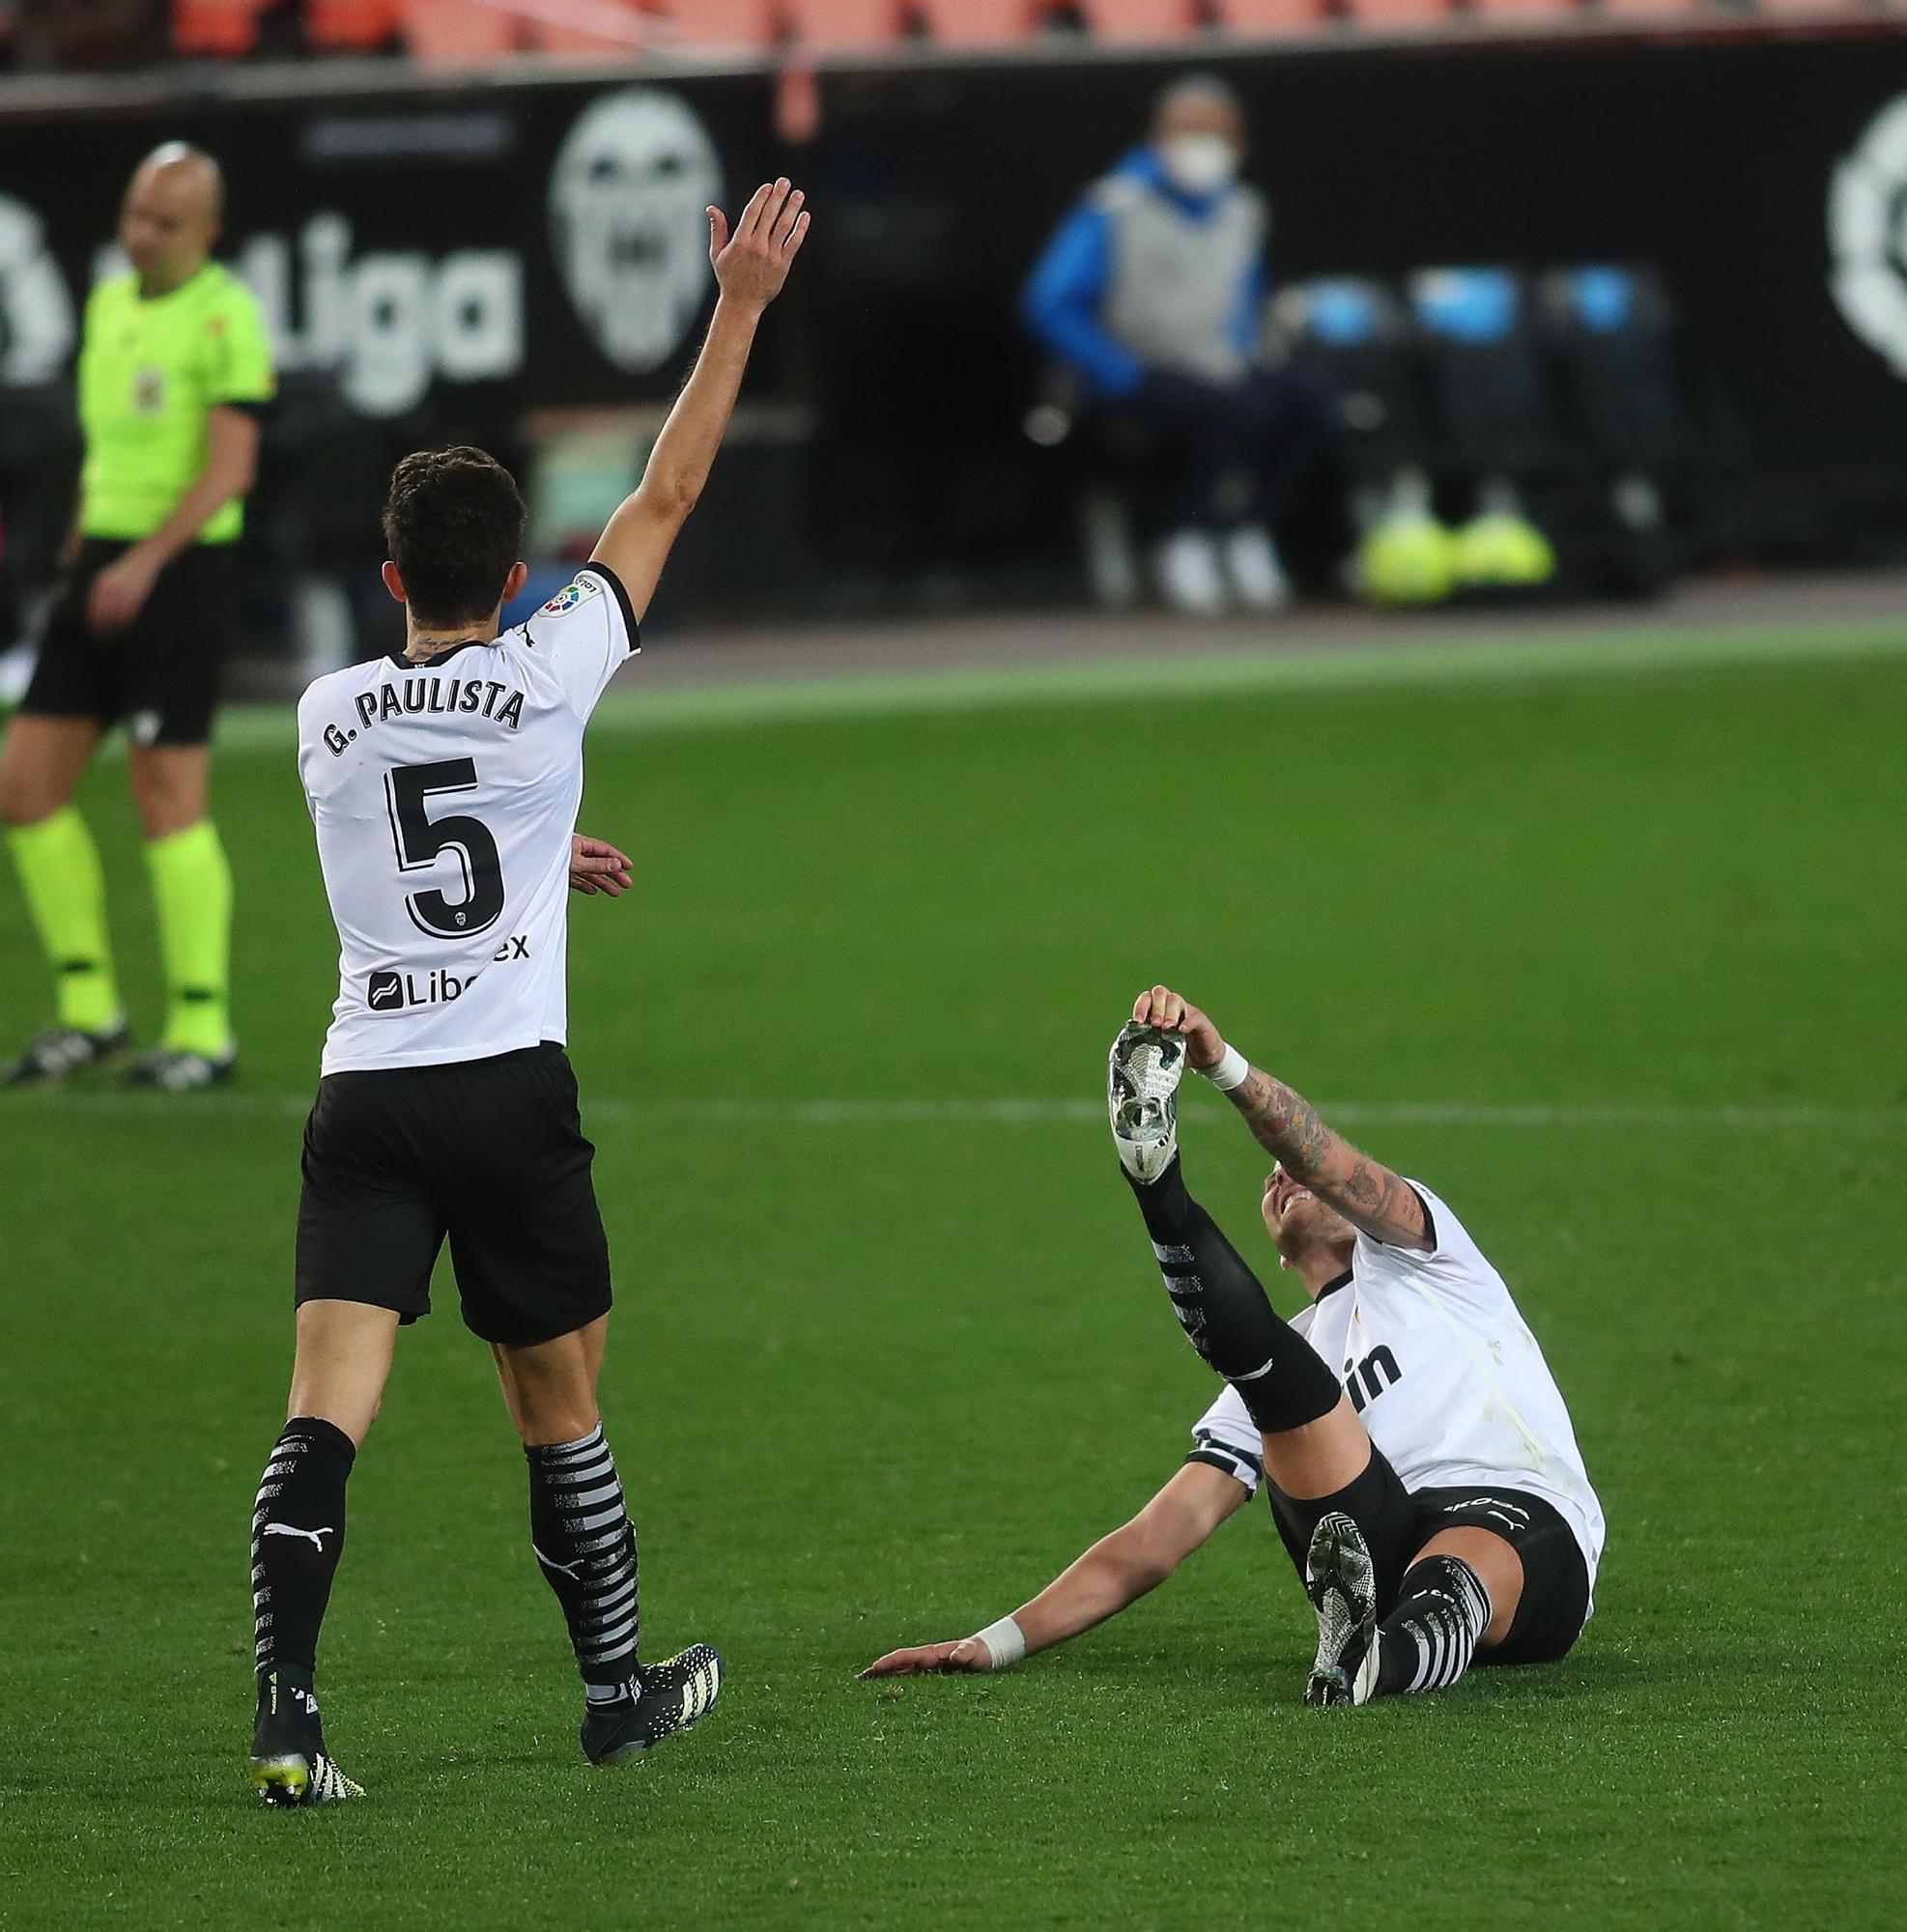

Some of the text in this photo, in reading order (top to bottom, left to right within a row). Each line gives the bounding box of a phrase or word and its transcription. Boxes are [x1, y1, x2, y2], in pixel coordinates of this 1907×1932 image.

[97, 214, 522, 413] Liga
[324, 678, 525, 756] G. PAULISTA
[384, 757, 505, 939] 5
[1344, 1345, 1402, 1414] in
